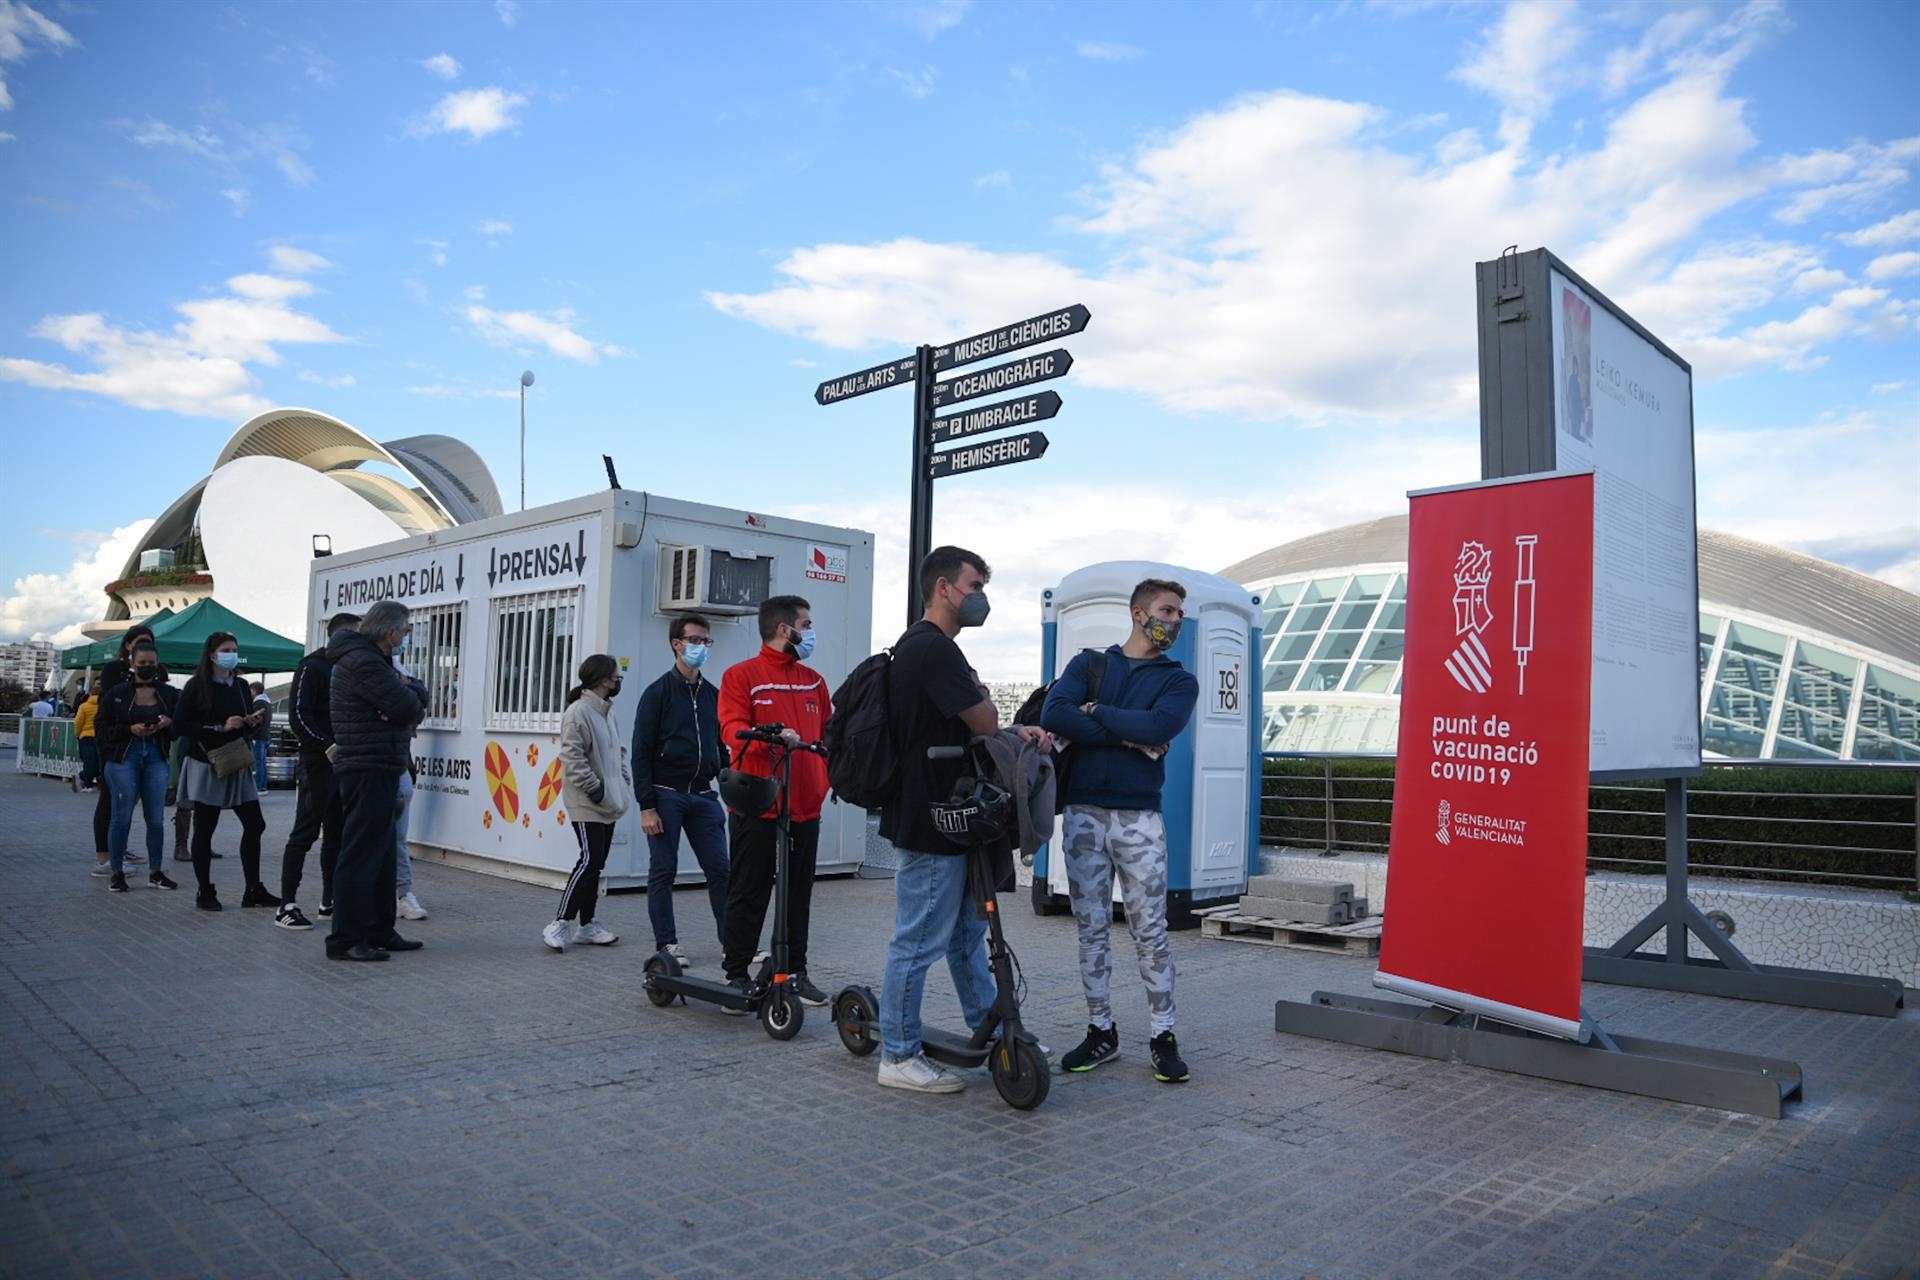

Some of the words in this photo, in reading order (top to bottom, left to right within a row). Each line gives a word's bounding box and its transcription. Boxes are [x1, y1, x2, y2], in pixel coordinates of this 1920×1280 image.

[955, 334, 997, 362] MUSEU
[999, 340, 1009, 349] LES
[1010, 312, 1071, 346] CIÈNCIES
[823, 378, 857, 400] PALAU
[867, 366, 895, 389] ARTS
[954, 356, 1055, 399] OCEANOGRÀFIC
[965, 400, 1037, 433] UMBRACLE
[952, 437, 1030, 470] HEMISFÈRIC
[500, 542, 573, 583] PRENSA
[337, 575, 394, 607] ENTRADA
[398, 571, 416, 598] DE
[420, 560, 444, 595] DÍA
[1218, 690, 1238, 710] TOI
[1432, 715, 1478, 737] punt
[1483, 714, 1511, 738] de
[415, 756, 426, 775] DE
[428, 757, 444, 777] LES
[445, 759, 471, 780] ARTS
[1432, 740, 1539, 765] vacunació
[1454, 812, 1527, 833] GENERALITAT
[1454, 826, 1524, 846] VALENCIANA
